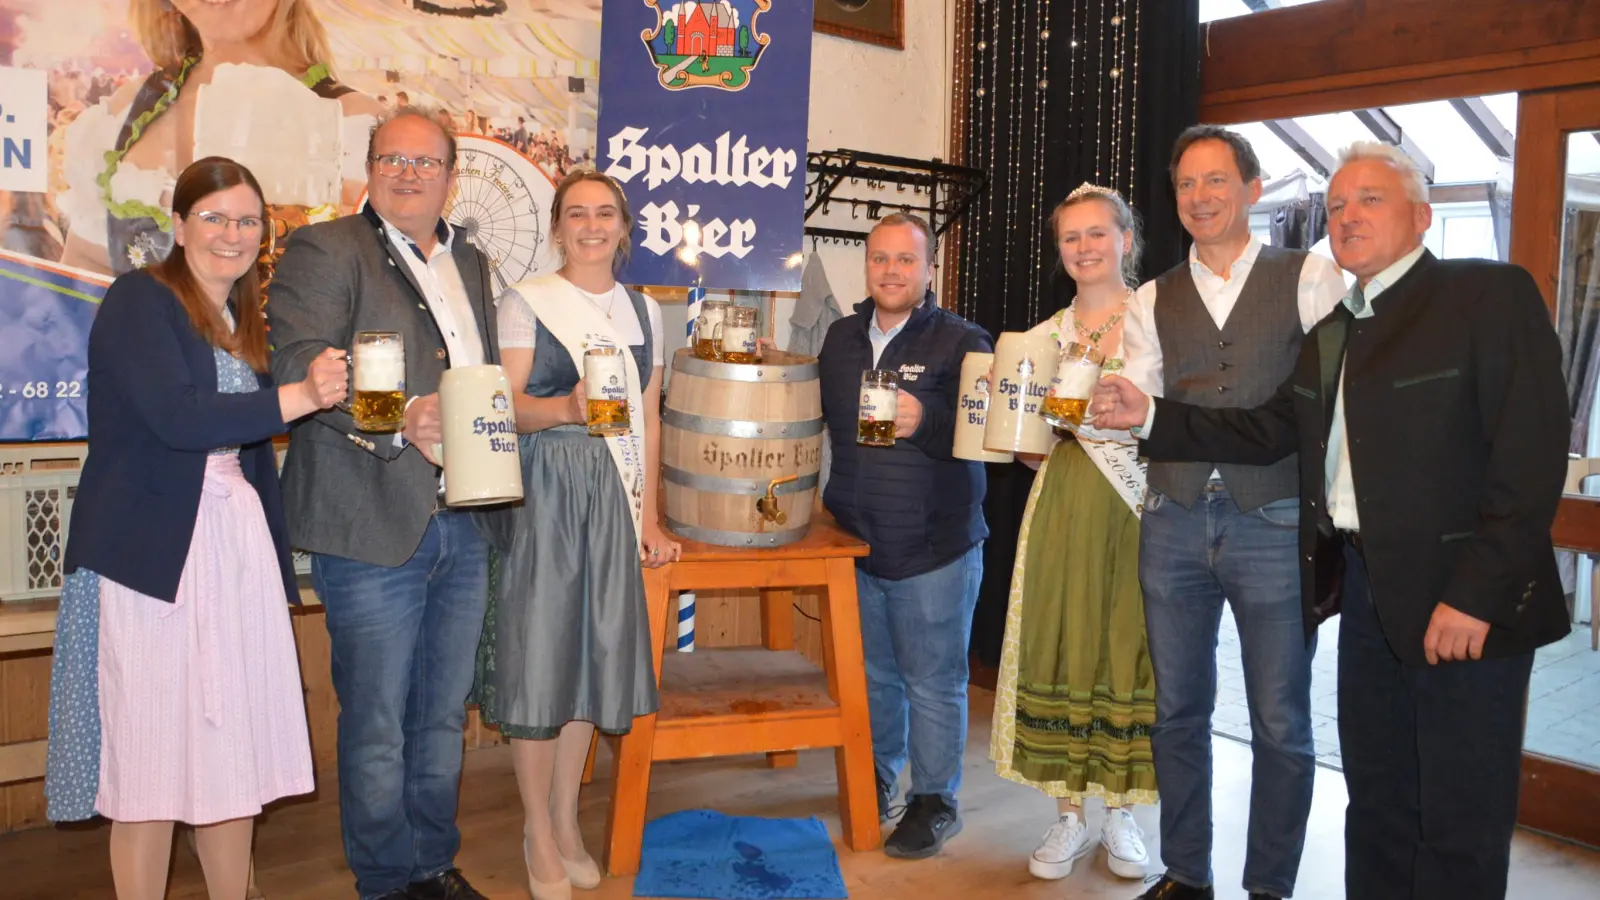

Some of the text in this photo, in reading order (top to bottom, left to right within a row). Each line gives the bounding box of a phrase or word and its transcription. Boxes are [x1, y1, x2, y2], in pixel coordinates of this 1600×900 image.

[602, 126, 797, 191] Spalter
[483, 167, 514, 200] Freizeit
[638, 200, 756, 259] Bier
[22, 381, 49, 399] 68
[56, 381, 81, 398] 22
[601, 385, 625, 394] Spalte
[1008, 398, 1037, 414] Ber
[473, 416, 517, 436] Spalt
[490, 437, 516, 453] Bier
[703, 441, 819, 472] Spalter Bier
[1093, 444, 1141, 489] -2026
